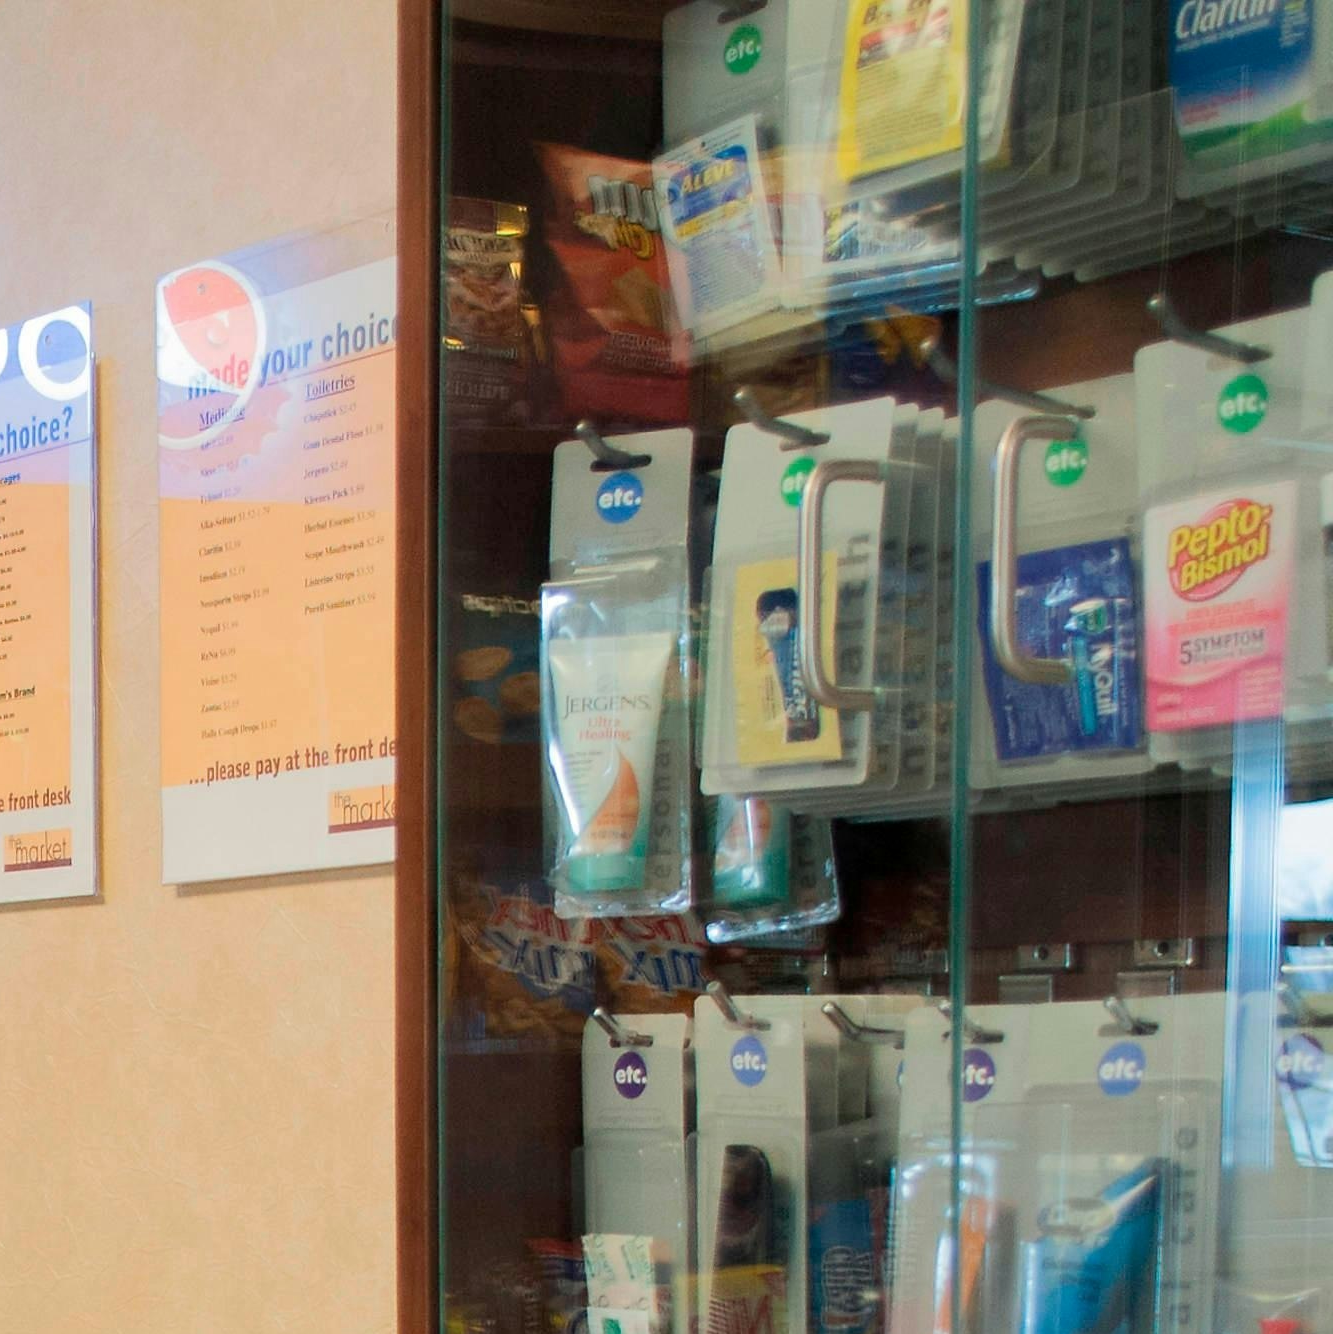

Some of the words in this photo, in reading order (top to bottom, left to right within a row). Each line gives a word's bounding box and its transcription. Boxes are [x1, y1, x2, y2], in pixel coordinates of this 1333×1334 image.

[725, 33, 763, 63] etc.
[259, 338, 313, 388] your
[305, 374, 356, 399] Toiletries
[1219, 393, 1267, 416] etc.
[1046, 448, 1087, 470] etc.
[598, 486, 642, 508] etc.
[1180, 528, 1269, 592] Bismol
[1179, 639, 1193, 665] 5
[1193, 629, 1264, 654] SYMPTOM
[564, 693, 652, 718] JERGENS
[588, 715, 621, 730] Ultra
[579, 728, 632, 743] Healing
[255, 757, 280, 781] pay
[285, 749, 301, 771] at
[305, 746, 329, 768] the
[334, 738, 373, 764] front
[8, 790, 39, 811] front
[43, 785, 71, 808] desk
[334, 791, 351, 806] the
[15, 832, 68, 863] market
[733, 1053, 768, 1072] etc.
[1098, 1060, 1144, 1080] etc.
[615, 1066, 648, 1085] etc.
[964, 1064, 994, 1086] tc.
